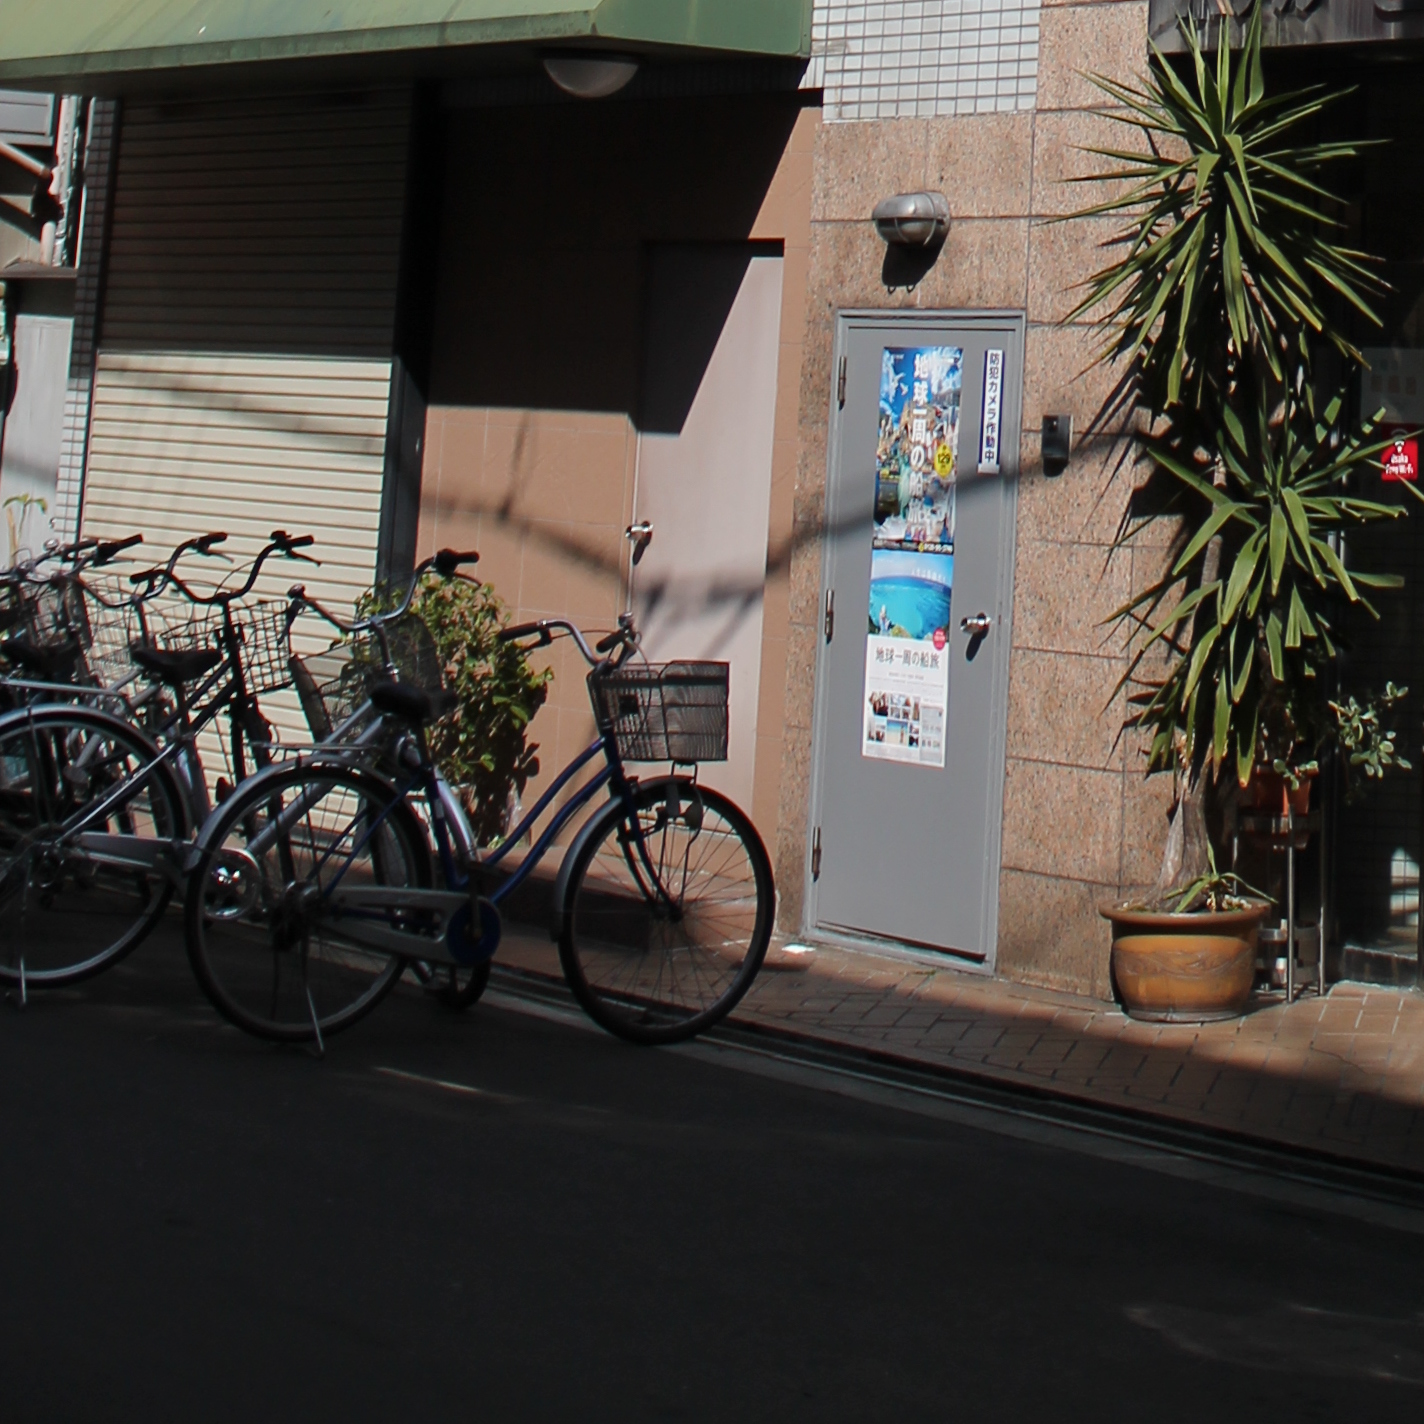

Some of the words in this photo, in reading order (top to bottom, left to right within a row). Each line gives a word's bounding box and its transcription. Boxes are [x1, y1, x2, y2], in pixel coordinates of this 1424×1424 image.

[984, 352, 999, 464] 防犯カメラ作動中
